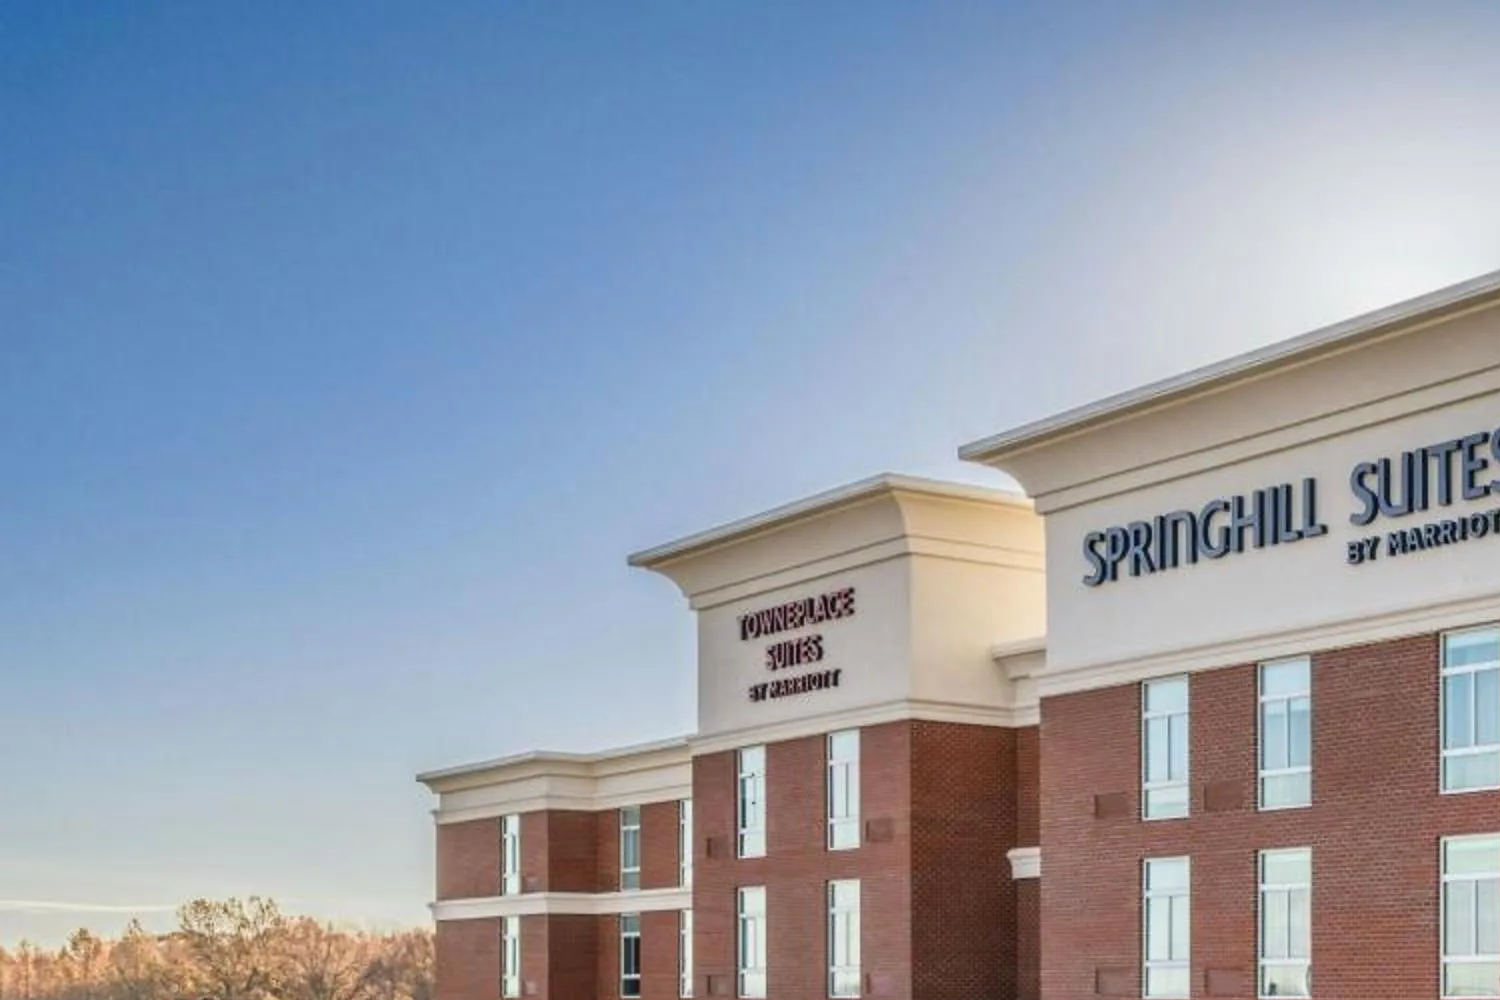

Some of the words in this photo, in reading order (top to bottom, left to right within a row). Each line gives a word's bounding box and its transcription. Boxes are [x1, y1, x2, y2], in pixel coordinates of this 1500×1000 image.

[1082, 477, 1329, 588] SPRINGHILL
[1347, 535, 1383, 566] BY
[737, 586, 856, 642] TOWNEPLACE
[765, 633, 825, 672] SUITES
[748, 682, 769, 702] BY
[769, 668, 843, 699] MARRIOTT
